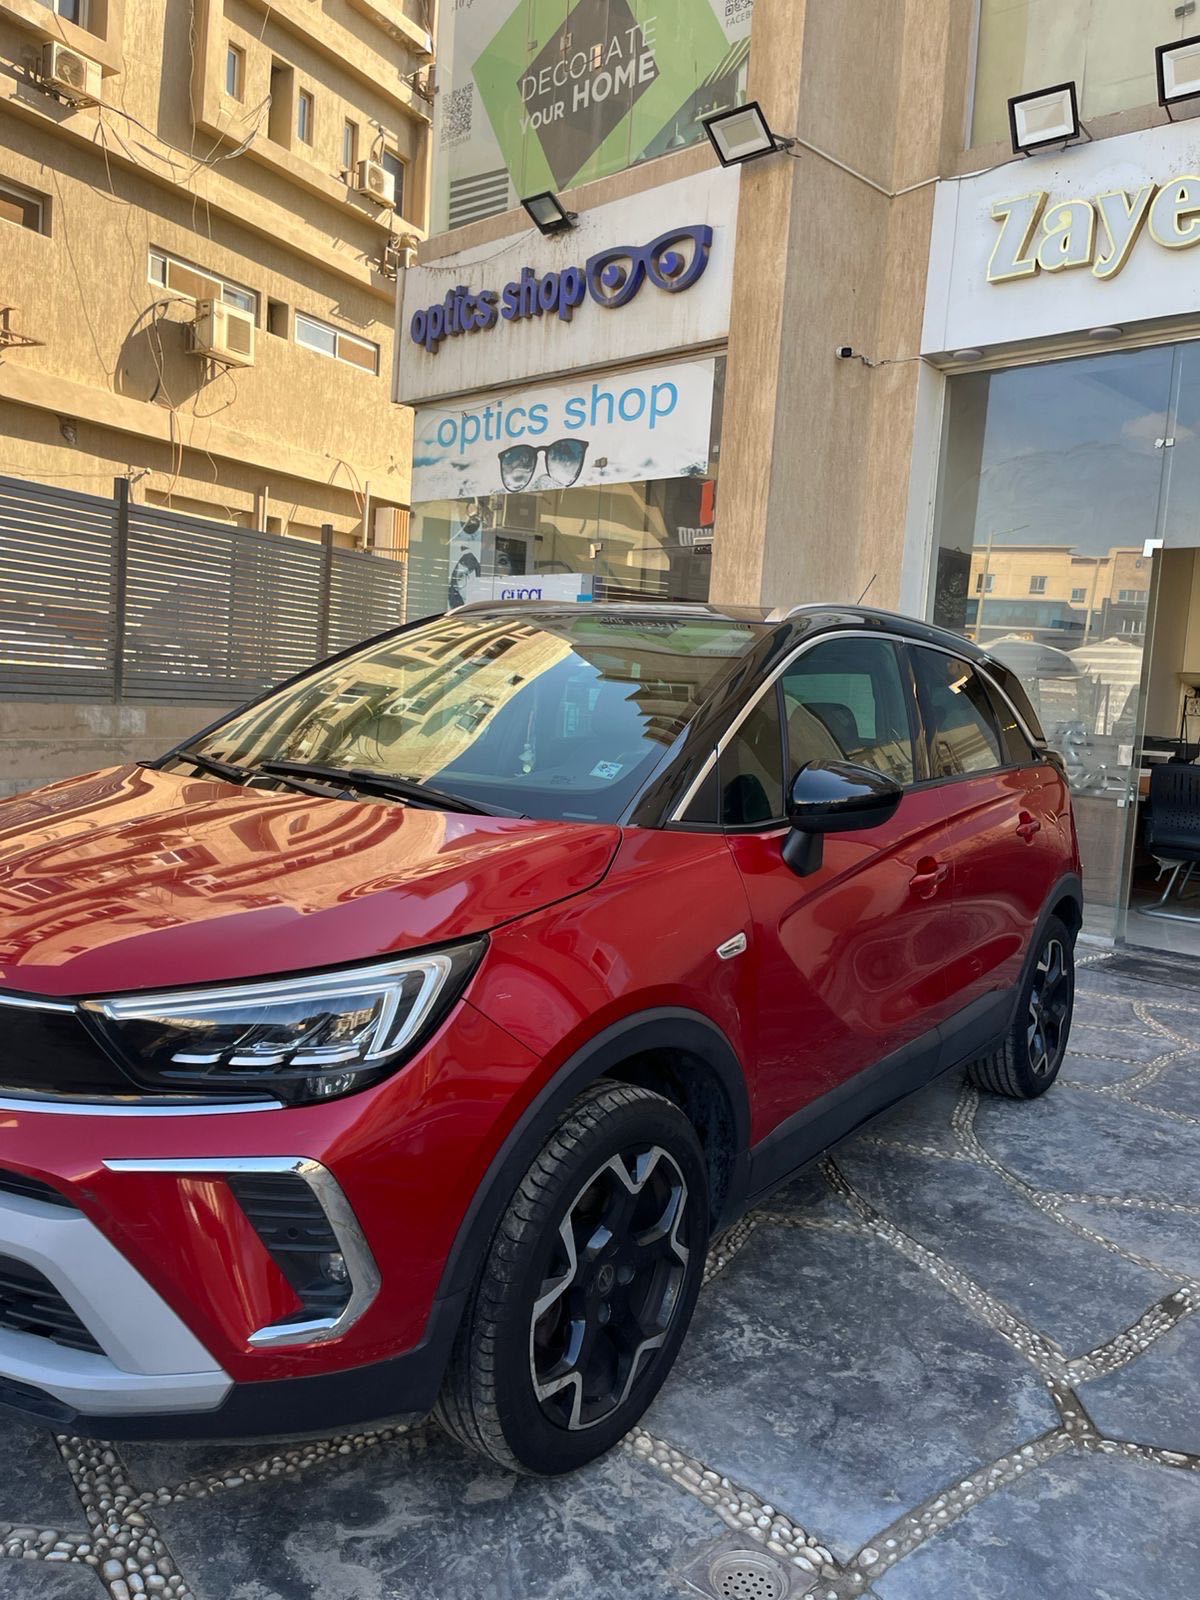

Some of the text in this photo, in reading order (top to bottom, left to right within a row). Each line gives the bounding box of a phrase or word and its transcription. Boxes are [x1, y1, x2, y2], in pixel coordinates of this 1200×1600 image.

[519, 49, 656, 135] YOUR HOME
[986, 174, 1200, 285] Zaye
[410, 266, 587, 355] optics shop
[437, 382, 679, 455] optics shop
